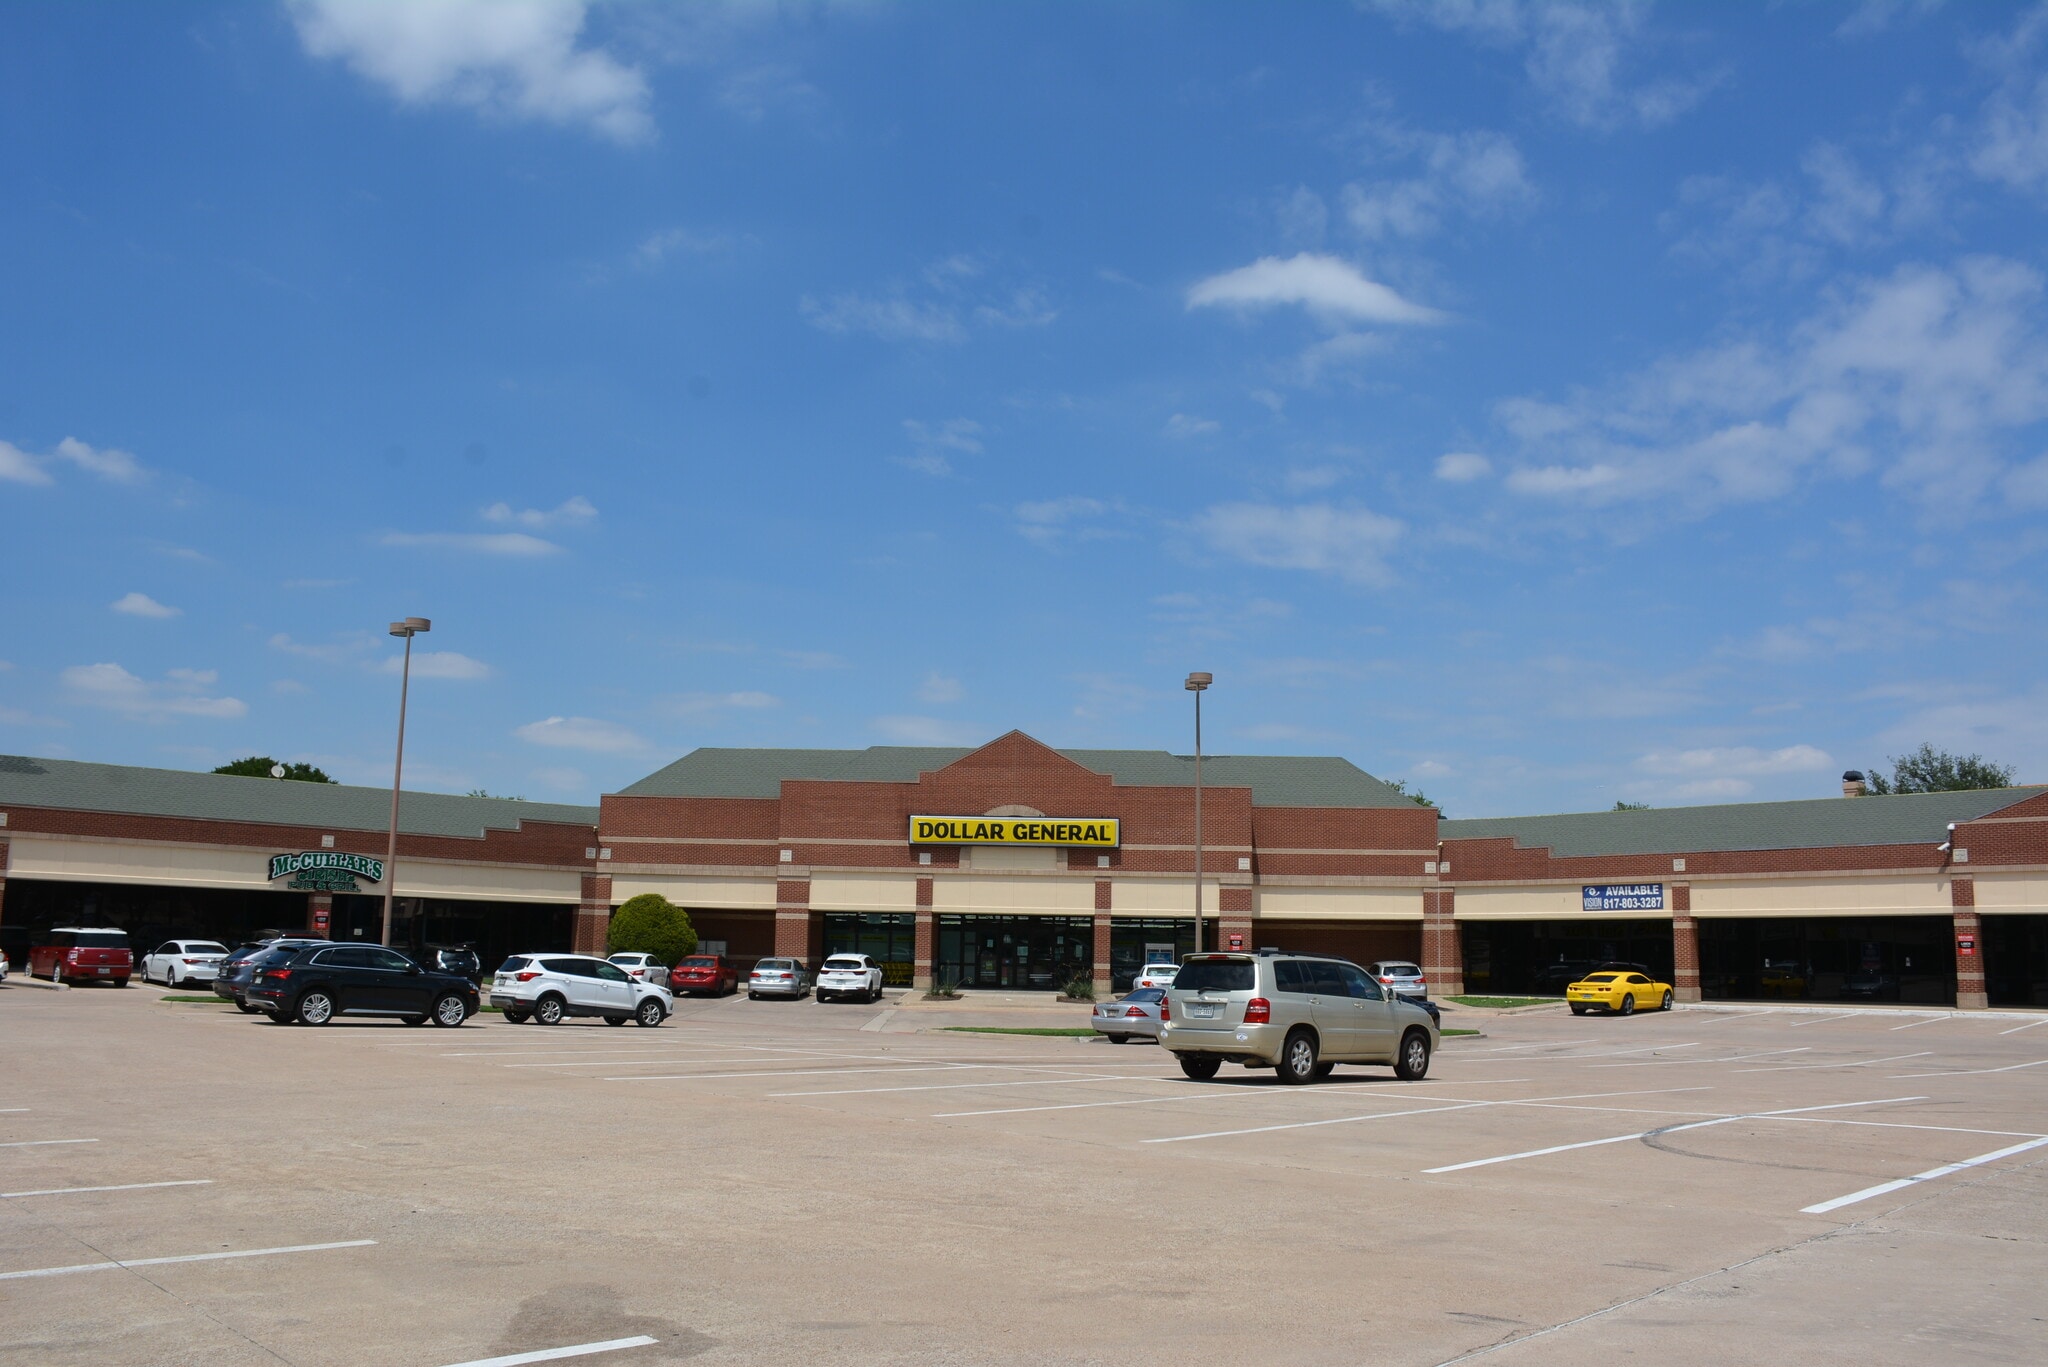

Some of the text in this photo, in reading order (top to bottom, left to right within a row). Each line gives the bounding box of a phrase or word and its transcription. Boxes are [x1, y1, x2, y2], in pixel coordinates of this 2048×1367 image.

[918, 822, 1111, 841] DOLLAR GENERAL
[288, 881, 314, 890] PUB
[328, 882, 362, 892] GRILL
[1606, 885, 1659, 896] AVAILABLE
[1584, 897, 1602, 907] VISION
[1603, 897, 1662, 909] 817-803-3287
